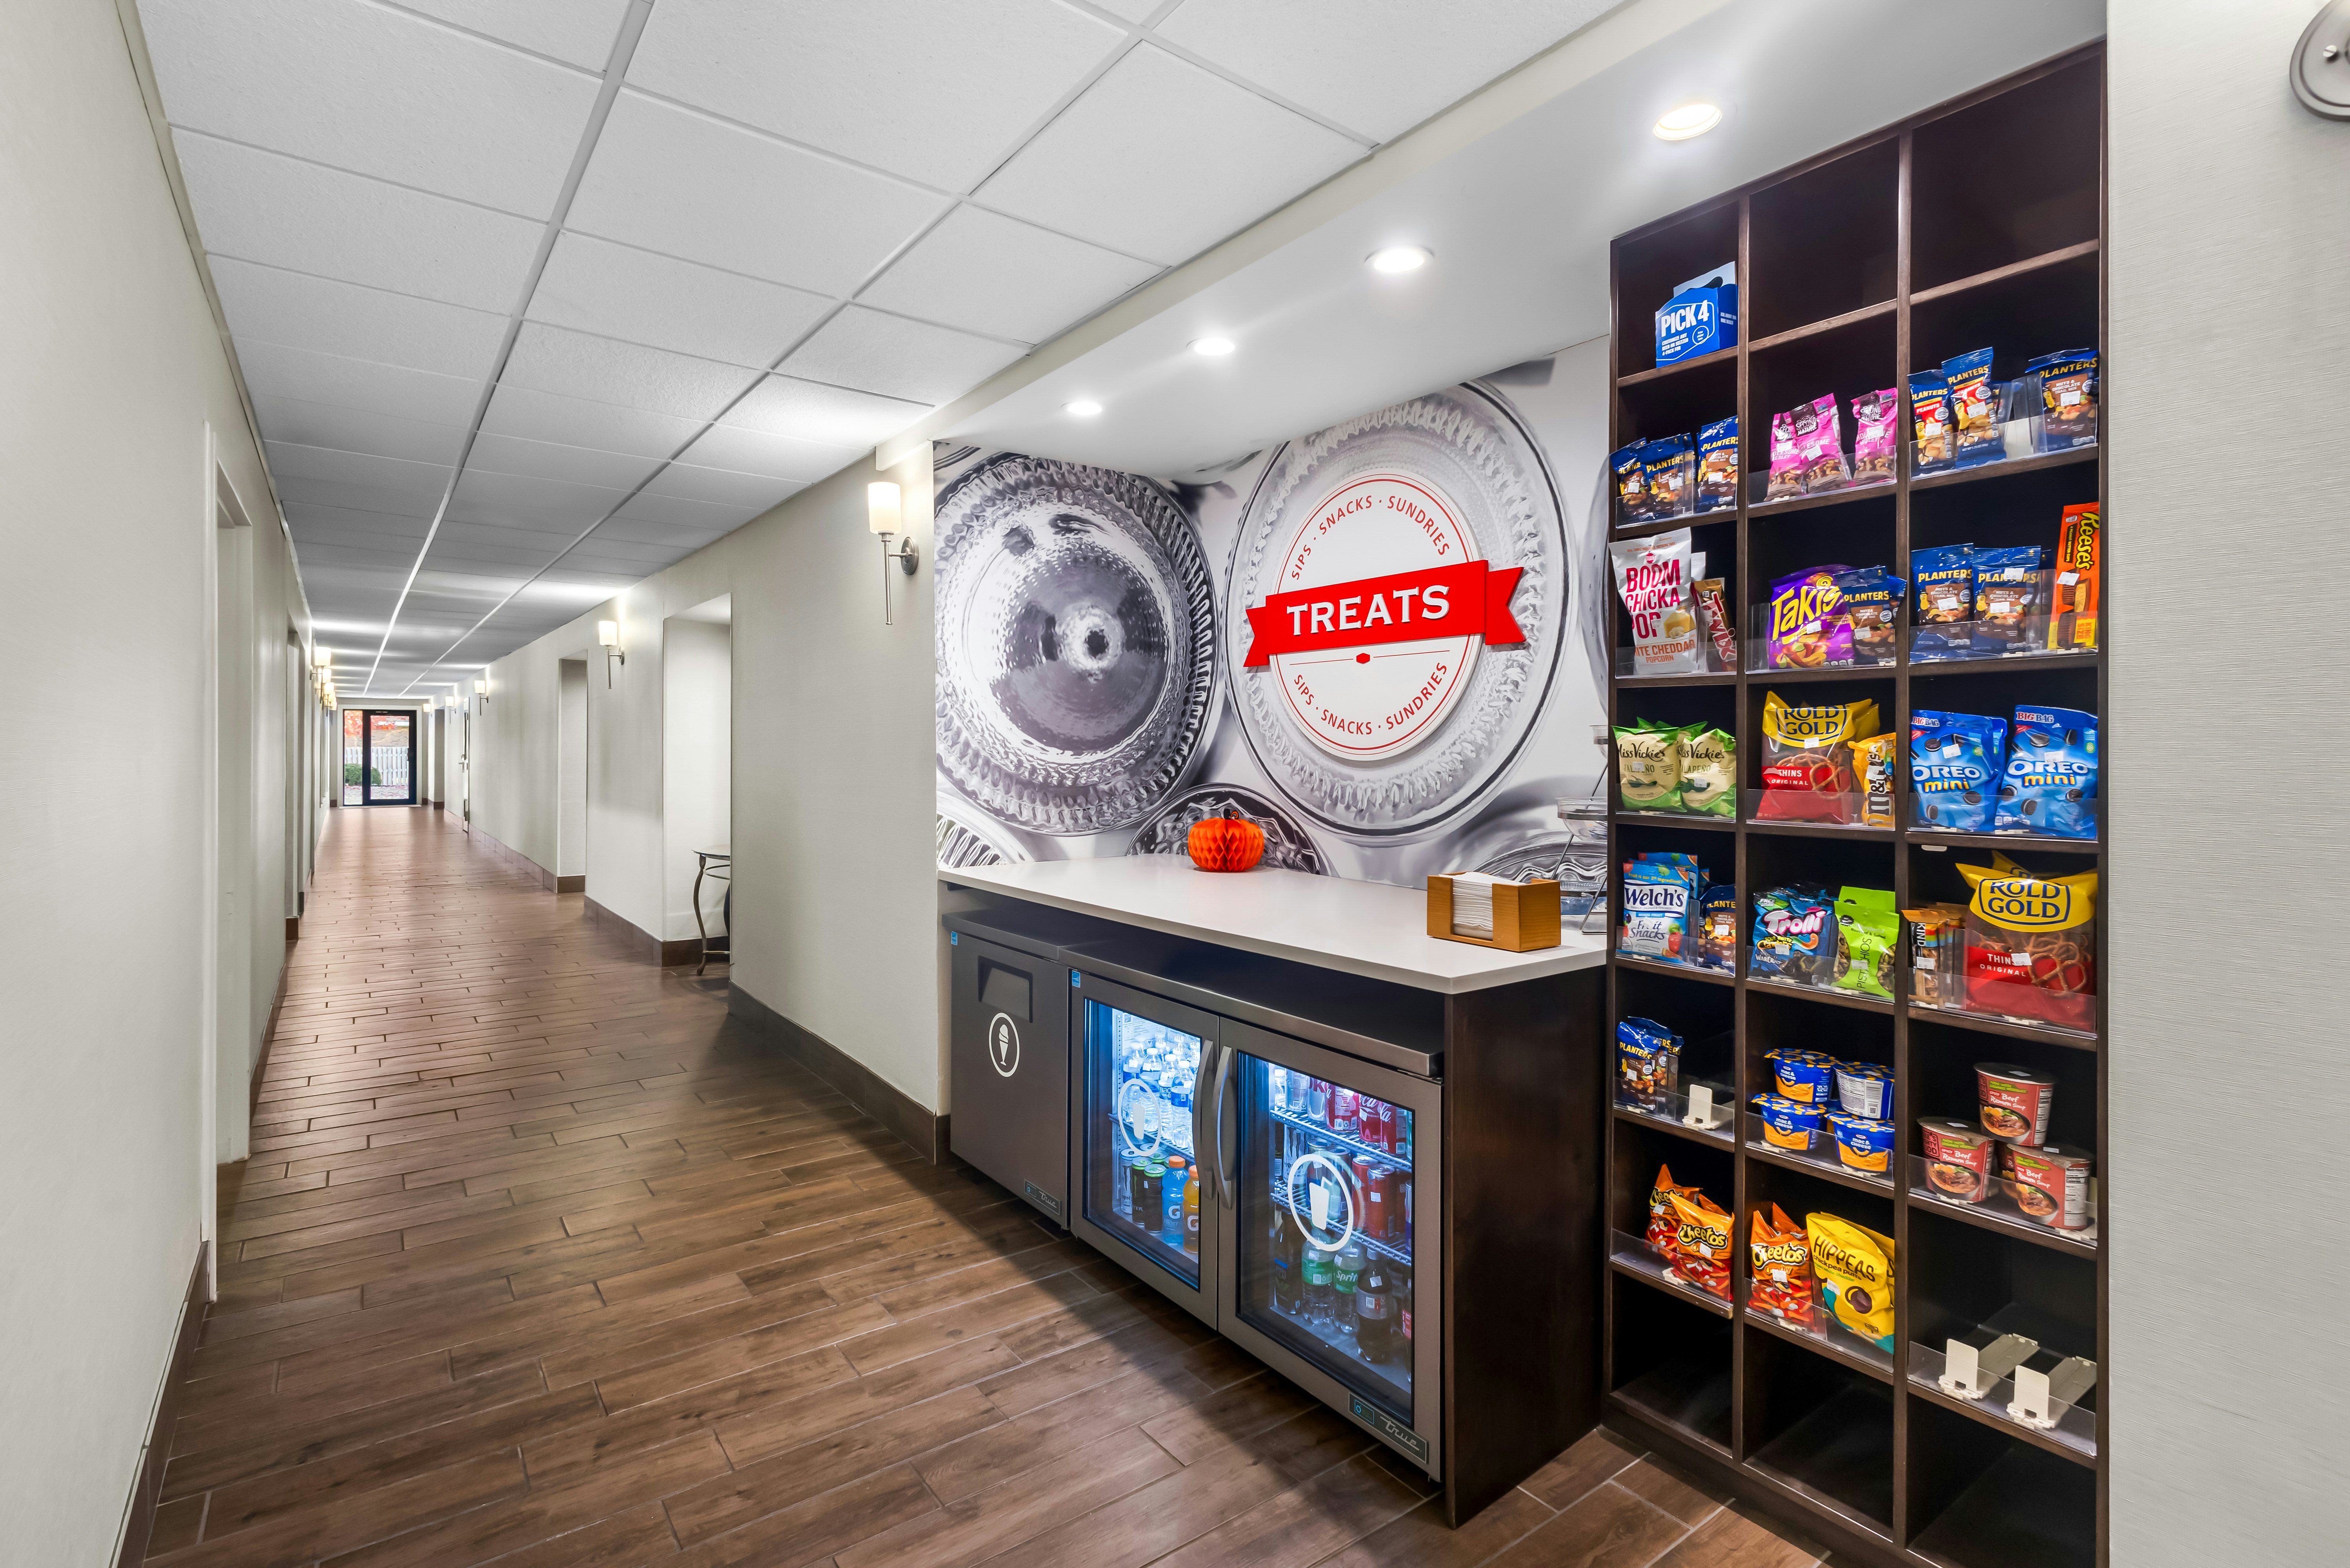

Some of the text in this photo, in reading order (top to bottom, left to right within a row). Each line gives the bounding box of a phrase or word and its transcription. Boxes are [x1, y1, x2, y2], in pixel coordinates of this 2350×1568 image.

[1661, 305, 1696, 337] PICK
[1698, 299, 1709, 321] 4
[1948, 365, 1989, 385] PLANTERS
[1912, 388, 1948, 400] PLANTERS
[1916, 403, 1940, 413] PEANUTS
[1796, 417, 1816, 430] SECOND
[1647, 454, 1684, 473] PLANTERS
[1292, 495, 1449, 580] SIPS SNACKS SUNDRIES
[1626, 559, 1680, 592] BOOM
[1918, 569, 1972, 583] PLANTERS
[1978, 572, 2038, 583] PLARS
[1625, 588, 1680, 612] CHICKA
[1844, 591, 1889, 603] PLANTERS
[1287, 585, 1450, 636] TREATS
[1772, 586, 1843, 641] Takis
[1632, 612, 1661, 639] OP
[1634, 639, 1695, 656] ITE CHEDDAR
[1646, 655, 1674, 663] POPCORN
[1294, 662, 1447, 735] SIPS SNACKS SUNDRIES
[1784, 706, 1840, 721] ROLD
[1786, 722, 1838, 735] GOLD
[1624, 764, 1654, 773] JALÑO
[1913, 766, 1980, 780] OREO
[2008, 760, 2088, 775] OREO
[1924, 779, 1969, 792] mini
[2024, 774, 2076, 786] mini
[1625, 887, 1684, 907] Welch's
[1990, 882, 2060, 899] ROLD
[1988, 897, 2060, 918] GOLD
[1637, 920, 1662, 929] Frit
[1764, 910, 1827, 935] Trolli
[1630, 927, 1665, 940] Snacks
[1916, 923, 1926, 947] KIND
[1857, 937, 1872, 989] PISTHIOS
[1980, 964, 2026, 977] ORIGINAL
[1990, 1096, 2012, 1107] Ramen
[2001, 1093, 2019, 1103] Beef
[1942, 1153, 1964, 1163] Ramen
[1954, 1151, 1972, 1159] Beef
[2018, 1171, 2050, 1189] Ramen Soup
[2026, 1169, 2043, 1180] Beef
[1168, 1205, 1180, 1219] G
[1678, 1224, 1726, 1246] Cheetos
[1752, 1245, 1805, 1267] Cheetos
[1813, 1255, 1841, 1272] chickpea
[1814, 1235, 1875, 1282] HIPPEAS
[1336, 1270, 1358, 1282] Sprit
